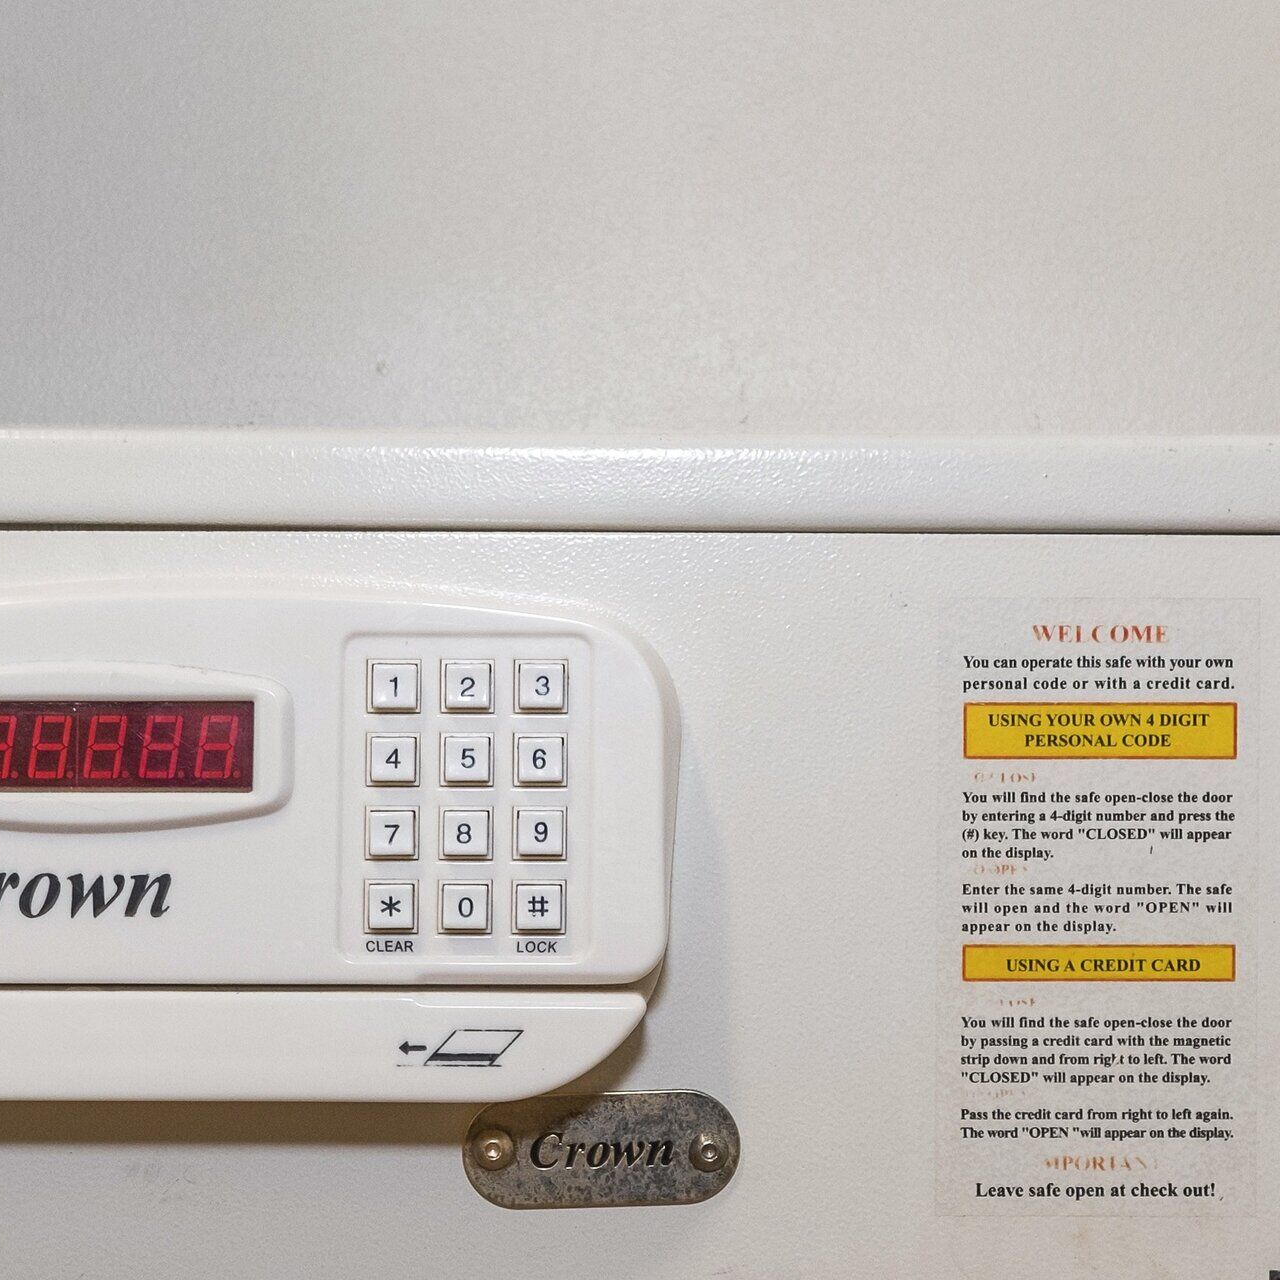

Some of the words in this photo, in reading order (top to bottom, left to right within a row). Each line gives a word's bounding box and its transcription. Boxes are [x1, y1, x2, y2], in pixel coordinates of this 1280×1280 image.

[1032, 624, 1170, 644] WELCOME
[963, 655, 989, 669] You
[993, 658, 1017, 669] can
[1021, 656, 1073, 672] operate
[1076, 655, 1102, 669] this
[1105, 655, 1132, 669] safe
[1136, 655, 1166, 668] with
[1169, 658, 1202, 672] your
[1205, 658, 1233, 669] own
[388, 676, 399, 698] 1
[460, 676, 476, 697] 2
[534, 675, 551, 696] 3
[963, 676, 1027, 694] personal
[1033, 677, 1067, 690] code
[1072, 680, 1089, 690] or
[1094, 676, 1127, 690] with
[1133, 679, 1141, 690] a
[1146, 676, 1191, 690] credit
[1196, 676, 1235, 690] card.
[988, 713, 1042, 727] USING
[1046, 713, 1096, 727] YOUR
[1099, 713, 1141, 727] OWN
[1146, 713, 1155, 727] 4
[1159, 713, 1210, 727] DIGIT
[1025, 734, 1117, 747] PERSONAL
[1121, 734, 1171, 747] CODE
[385, 748, 402, 769] 4
[460, 748, 476, 769] 5
[532, 748, 547, 770] 6
[962, 791, 987, 803] You
[992, 791, 1016, 803] will
[1020, 791, 1046, 803] find
[1050, 791, 1071, 803] the
[1075, 791, 1101, 803] safe
[1104, 791, 1174, 806] open-close
[1177, 791, 1198, 803] the
[1202, 791, 1233, 803] door
[962, 810, 978, 825] by
[981, 810, 1036, 825] entering
[1039, 812, 1046, 822] a
[1049, 809, 1092, 825] 4-digit
[1096, 810, 1147, 822] number
[1150, 809, 1174, 822] and
[1178, 812, 1212, 825] press
[1215, 809, 1235, 822] the
[384, 824, 400, 845] 7
[456, 823, 472, 844] 8
[533, 821, 548, 843] 9
[962, 828, 980, 843] (#)
[983, 828, 1008, 843] key.
[1011, 828, 1037, 840] The
[1040, 828, 1074, 840] word
[1078, 828, 1155, 840] "CLOSED"
[1159, 828, 1183, 840] will
[1186, 831, 1232, 843] appear
[961, 849, 978, 859] on
[981, 846, 1002, 859] the
[1005, 846, 1054, 862] display.
[962, 883, 1000, 895] Enter
[1004, 883, 1026, 896] the
[1029, 886, 1064, 896] same
[1068, 883, 1112, 899] 4-digit
[1116, 883, 1172, 895] number.
[1175, 883, 1202, 895] The
[1206, 883, 1233, 895] safe
[458, 896, 474, 918] 0
[527, 895, 549, 917] #
[961, 902, 988, 914] will
[994, 905, 1028, 917] open
[1034, 902, 1060, 914] and
[1066, 901, 1089, 914] the
[1094, 902, 1130, 914] word
[1137, 901, 1199, 914] "OPEN"
[1205, 901, 1232, 913] will
[961, 923, 1011, 935] appear
[1015, 923, 1032, 932] on
[1036, 920, 1058, 932] the
[1063, 920, 1117, 935] display.
[365, 940, 414, 953] CLEAR
[516, 940, 558, 954] LOCK
[1006, 958, 1060, 972] USING
[1063, 959, 1076, 972] A
[1080, 958, 1147, 972] CREDIT
[1151, 958, 1201, 972] CARD
[961, 1016, 986, 1028] You
[991, 1016, 1015, 1028] will
[1019, 1016, 1045, 1028] find
[1049, 1016, 1070, 1028] the
[1073, 1016, 1100, 1028] safe
[1103, 1016, 1173, 1031] open-close
[1176, 1016, 1198, 1028] the
[1201, 1016, 1233, 1028] door
[960, 1035, 977, 1050] by
[980, 1035, 1029, 1050] passing
[1031, 1037, 1039, 1047] a
[1042, 1035, 1080, 1047] credit
[1083, 1034, 1113, 1047] card
[1116, 1034, 1145, 1047] with
[1149, 1035, 1170, 1047] the
[1173, 1034, 1231, 1050] magnetic
[960, 1053, 990, 1068] strip
[993, 1053, 1028, 1065] down
[1031, 1053, 1055, 1065] and
[1059, 1053, 1090, 1065] from
[1127, 1054, 1141, 1065] to
[1143, 1053, 1168, 1065] left.
[1170, 1053, 1196, 1065] The
[1199, 1053, 1231, 1065] word
[961, 1071, 1039, 1084] "CLOSED"
[1042, 1071, 1066, 1083] will
[1070, 1074, 1115, 1087] appear
[1118, 1074, 1134, 1083] on
[1138, 1071, 1159, 1083] the
[1161, 1071, 1211, 1086] display.
[960, 1108, 988, 1120] Pass
[991, 1108, 1012, 1120] the
[1014, 1108, 1052, 1120] credit
[1054, 1108, 1083, 1120] card
[1087, 1108, 1118, 1120] from
[1121, 1108, 1153, 1124] right
[1155, 1110, 1169, 1120] to
[1171, 1108, 1192, 1120] left
[1195, 1108, 1234, 1124] again.
[960, 1126, 985, 1139] The
[987, 1126, 1019, 1139] word
[1104, 1129, 1147, 1142] appear
[1149, 1129, 1165, 1139] on
[1167, 1127, 1187, 1139] the
[1189, 1126, 1234, 1142] display.
[528, 1131, 676, 1171] Crown
[975, 1182, 1024, 1198] Leave
[1028, 1182, 1061, 1198] safe
[1065, 1186, 1105, 1201] open
[1110, 1184, 1126, 1198] at
[1130, 1182, 1178, 1198] check
[1182, 1182, 1216, 1198] out!
